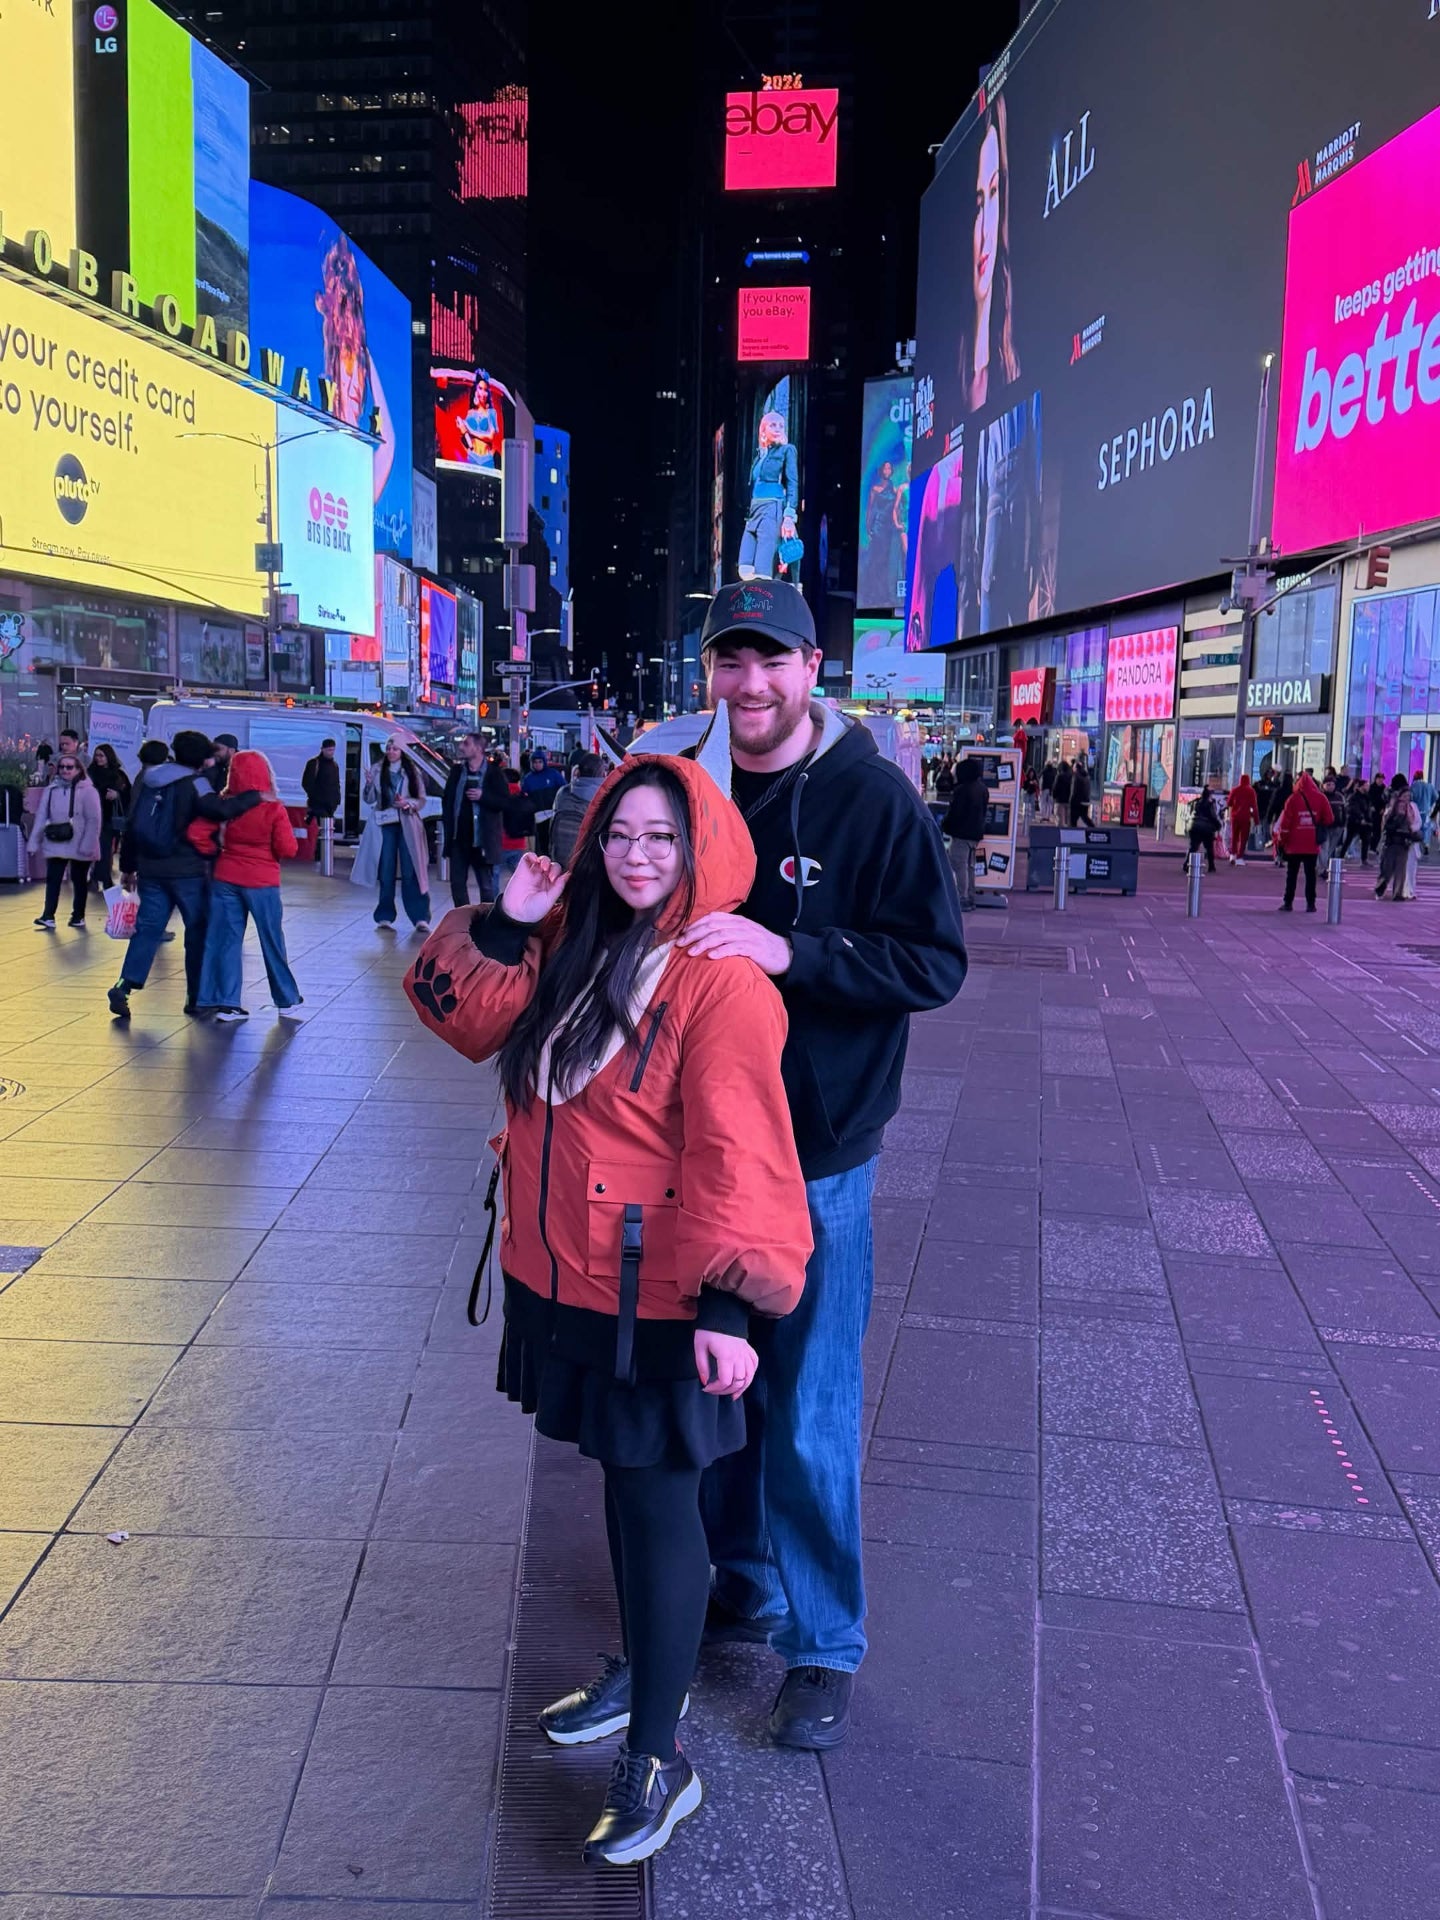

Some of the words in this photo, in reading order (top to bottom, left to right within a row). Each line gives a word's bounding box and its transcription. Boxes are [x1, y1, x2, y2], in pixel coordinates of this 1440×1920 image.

[95, 37, 117, 53] LG
[761, 73, 803, 90] 2026
[726, 92, 838, 143] ebay
[1315, 121, 1361, 166] MARRIOTT
[1043, 110, 1095, 218] ALL
[1314, 145, 1354, 186] MARQUIS
[743, 293, 750, 303] If
[753, 295, 773, 305] you
[775, 292, 806, 304] know,
[743, 308, 763, 319] you
[765, 306, 795, 318] eBay.
[1334, 280, 1380, 324] keeps
[69, 249, 337, 413] BROADWAY
[0, 323, 57, 370] your
[66, 350, 139, 403] credit
[146, 382, 195, 425] card
[30, 390, 138, 455] yourself.
[1098, 387, 1214, 490] SEPHORA
[55, 474, 90, 504] pluto
[90, 478, 100, 495] tv
[32, 537, 59, 553] Stream
[307, 520, 321, 545] BTS
[323, 525, 331, 548] IS
[333, 529, 351, 553] BACK
[1117, 661, 1162, 688] PANDORA
[1247, 679, 1312, 707] SEPHORA
